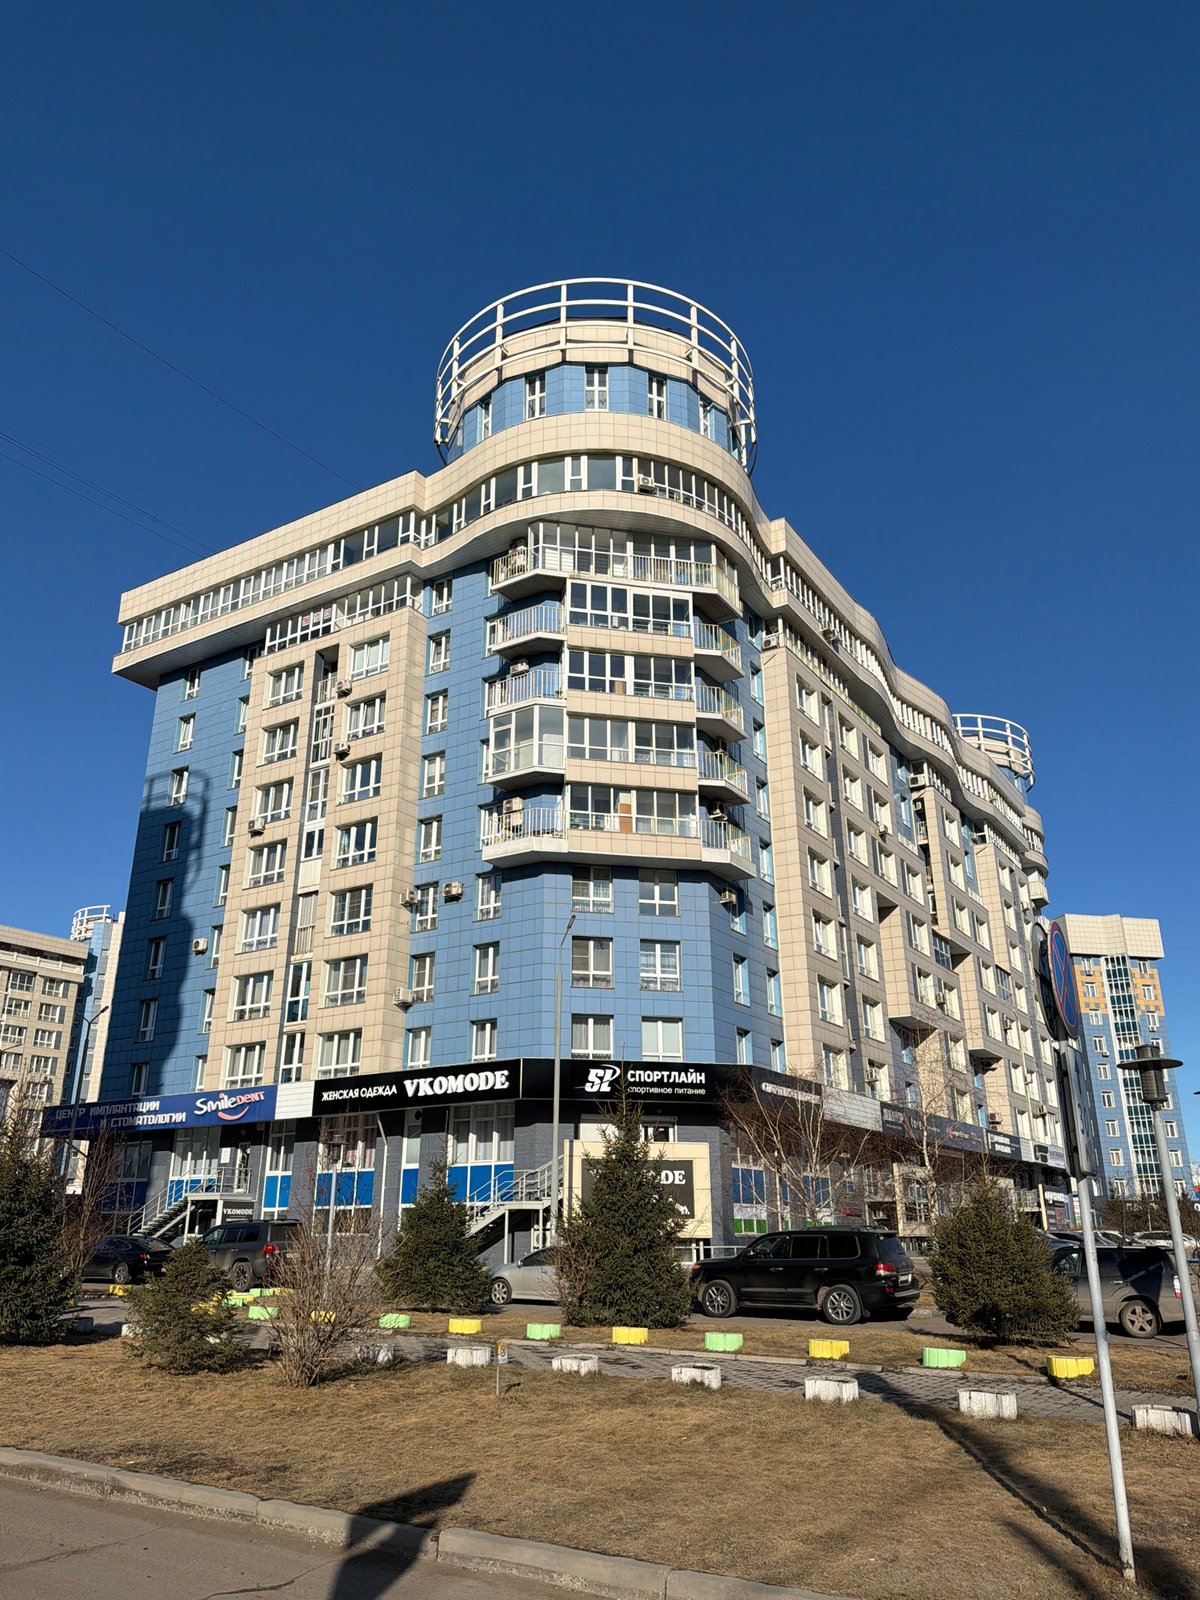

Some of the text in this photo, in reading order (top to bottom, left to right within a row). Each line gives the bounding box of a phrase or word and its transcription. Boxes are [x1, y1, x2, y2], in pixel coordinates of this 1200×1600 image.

[403, 1070, 510, 1097] VKOMODE
[627, 1069, 706, 1084] СПОРТЛАЙН
[321, 1085, 397, 1101] ЖЕНСКАЯ ОДЕЖДА
[627, 1086, 706, 1095] спортивное питание
[90, 1100, 160, 1116] ИМПЛАНТАЦИИ
[110, 1112, 186, 1128] СТОМАТОЛОГИИ
